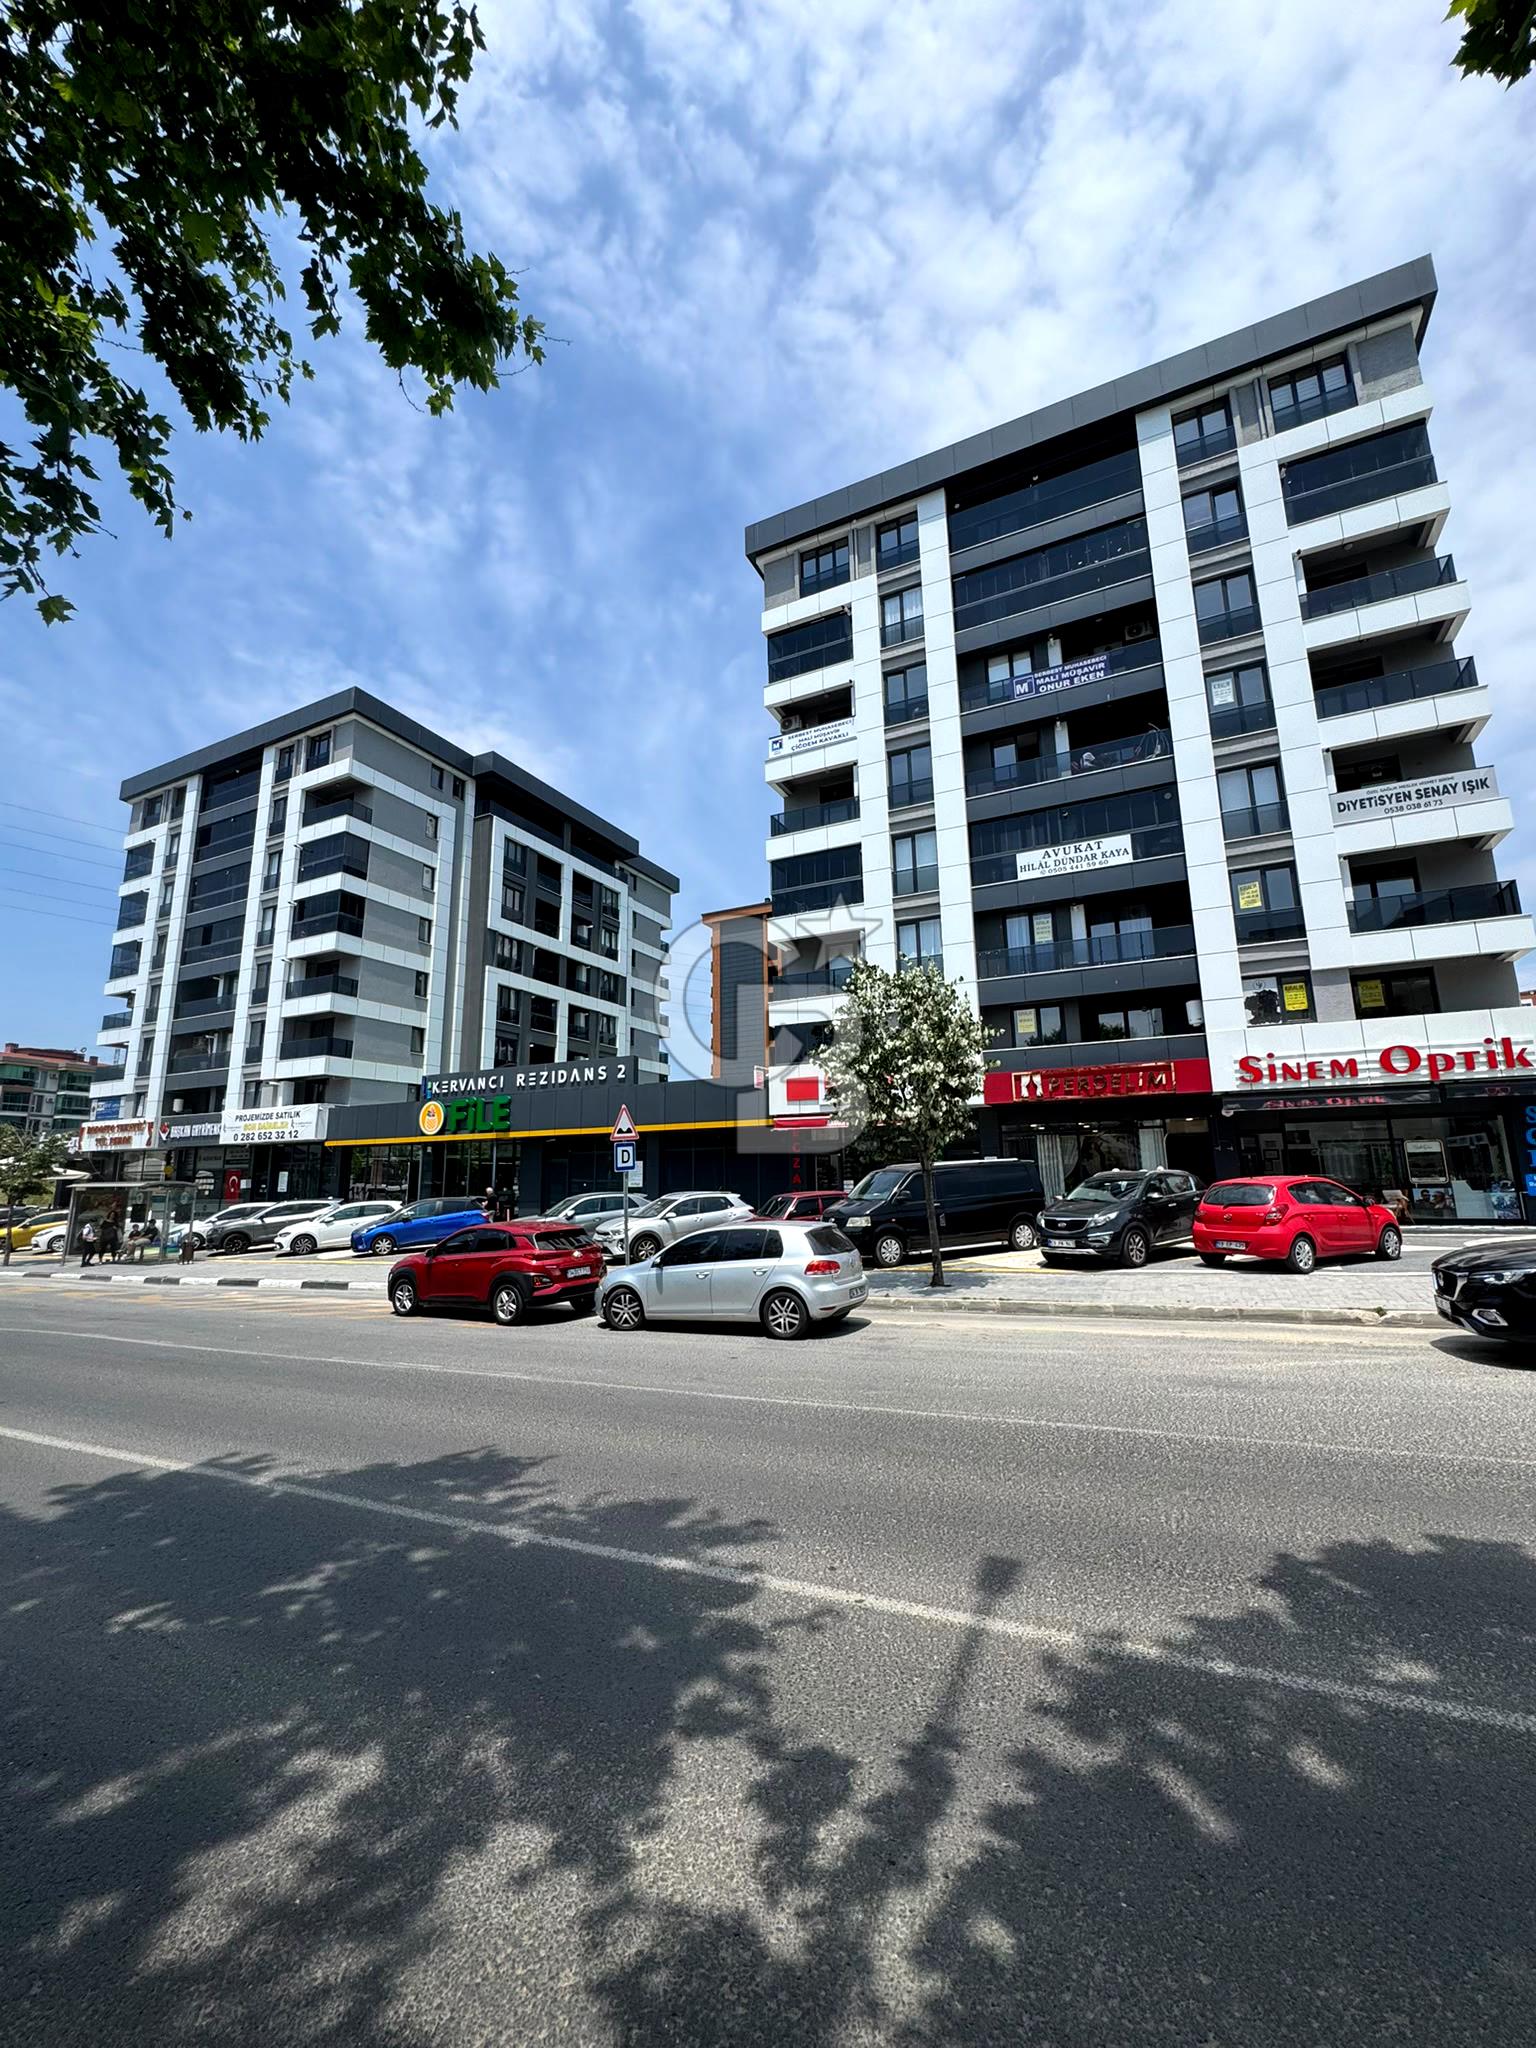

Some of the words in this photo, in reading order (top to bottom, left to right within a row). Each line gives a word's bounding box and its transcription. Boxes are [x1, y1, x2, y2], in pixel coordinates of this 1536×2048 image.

[1039, 679, 1070, 693] ONUR
[1073, 670, 1105, 685] EKEN
[819, 732, 849, 744] KAVAKLI
[1415, 783, 1459, 801] SENAY
[1462, 777, 1490, 795] IŞIK
[1384, 805, 1405, 815] 0538
[1406, 803, 1422, 811] 038
[1433, 798, 1443, 807] 73
[1042, 841, 1103, 859] AVUKAT
[1100, 848, 1130, 859] KAYA
[1047, 866, 1068, 874] 0505
[431, 1075, 504, 1094] KERVANCI
[516, 1065, 607, 1088] REZIDANS
[616, 1064, 626, 1079] 2
[235, 1111, 273, 1122] PROJEMİZDE
[274, 1110, 301, 1120] SATILIK
[233, 1133, 238, 1141] 0
[241, 1132, 255, 1141] 282
[257, 1131, 272, 1140] 652
[275, 1130, 286, 1139] 32
[288, 1129, 299, 1139] 12
[621, 1149, 631, 1164] D
